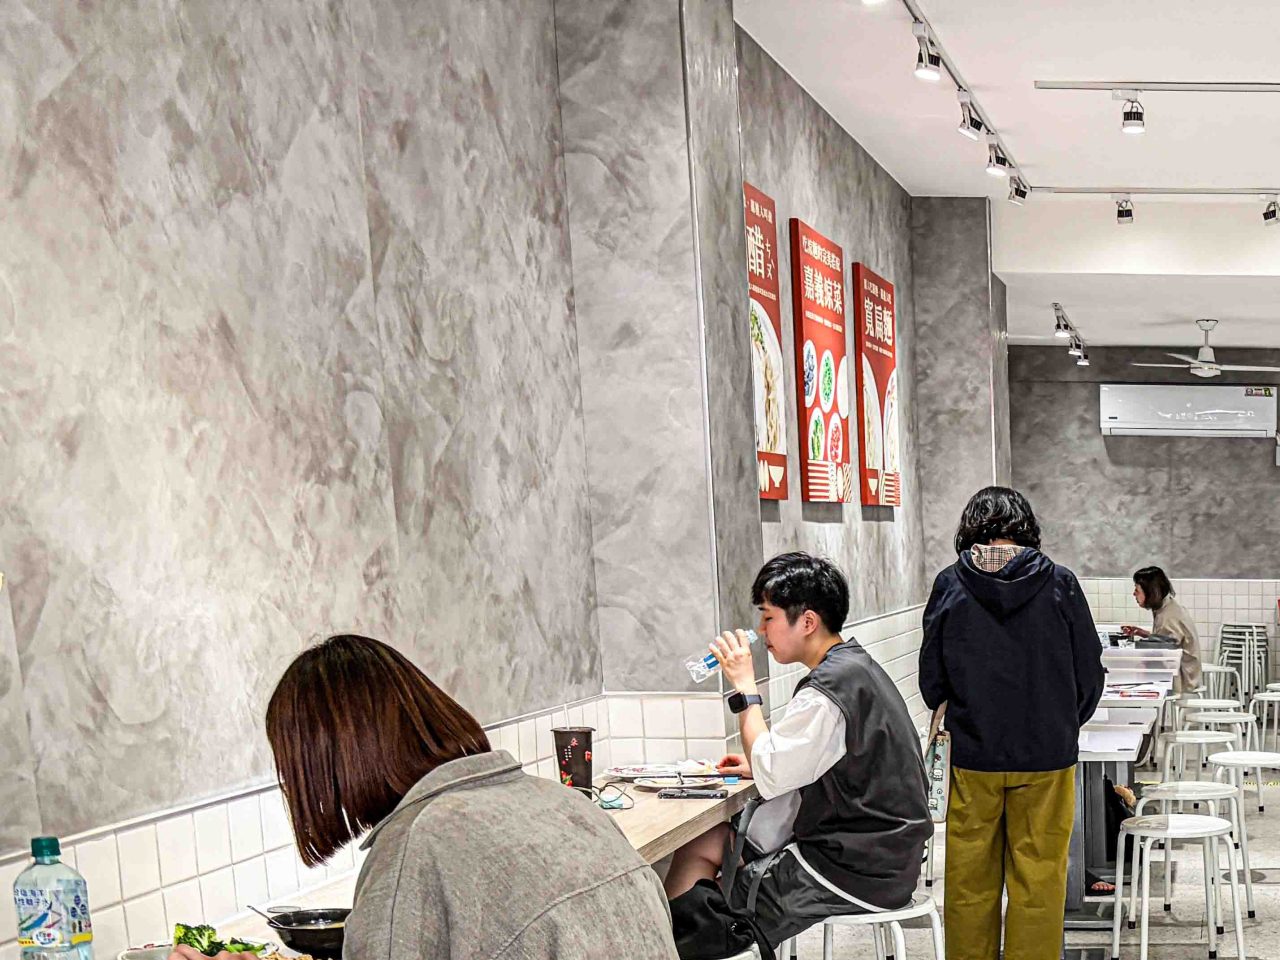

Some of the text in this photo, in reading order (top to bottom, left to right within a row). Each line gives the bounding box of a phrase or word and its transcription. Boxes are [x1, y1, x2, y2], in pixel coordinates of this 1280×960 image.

[746, 224, 765, 279] 醋
[864, 296, 893, 347] 寬扁麵
